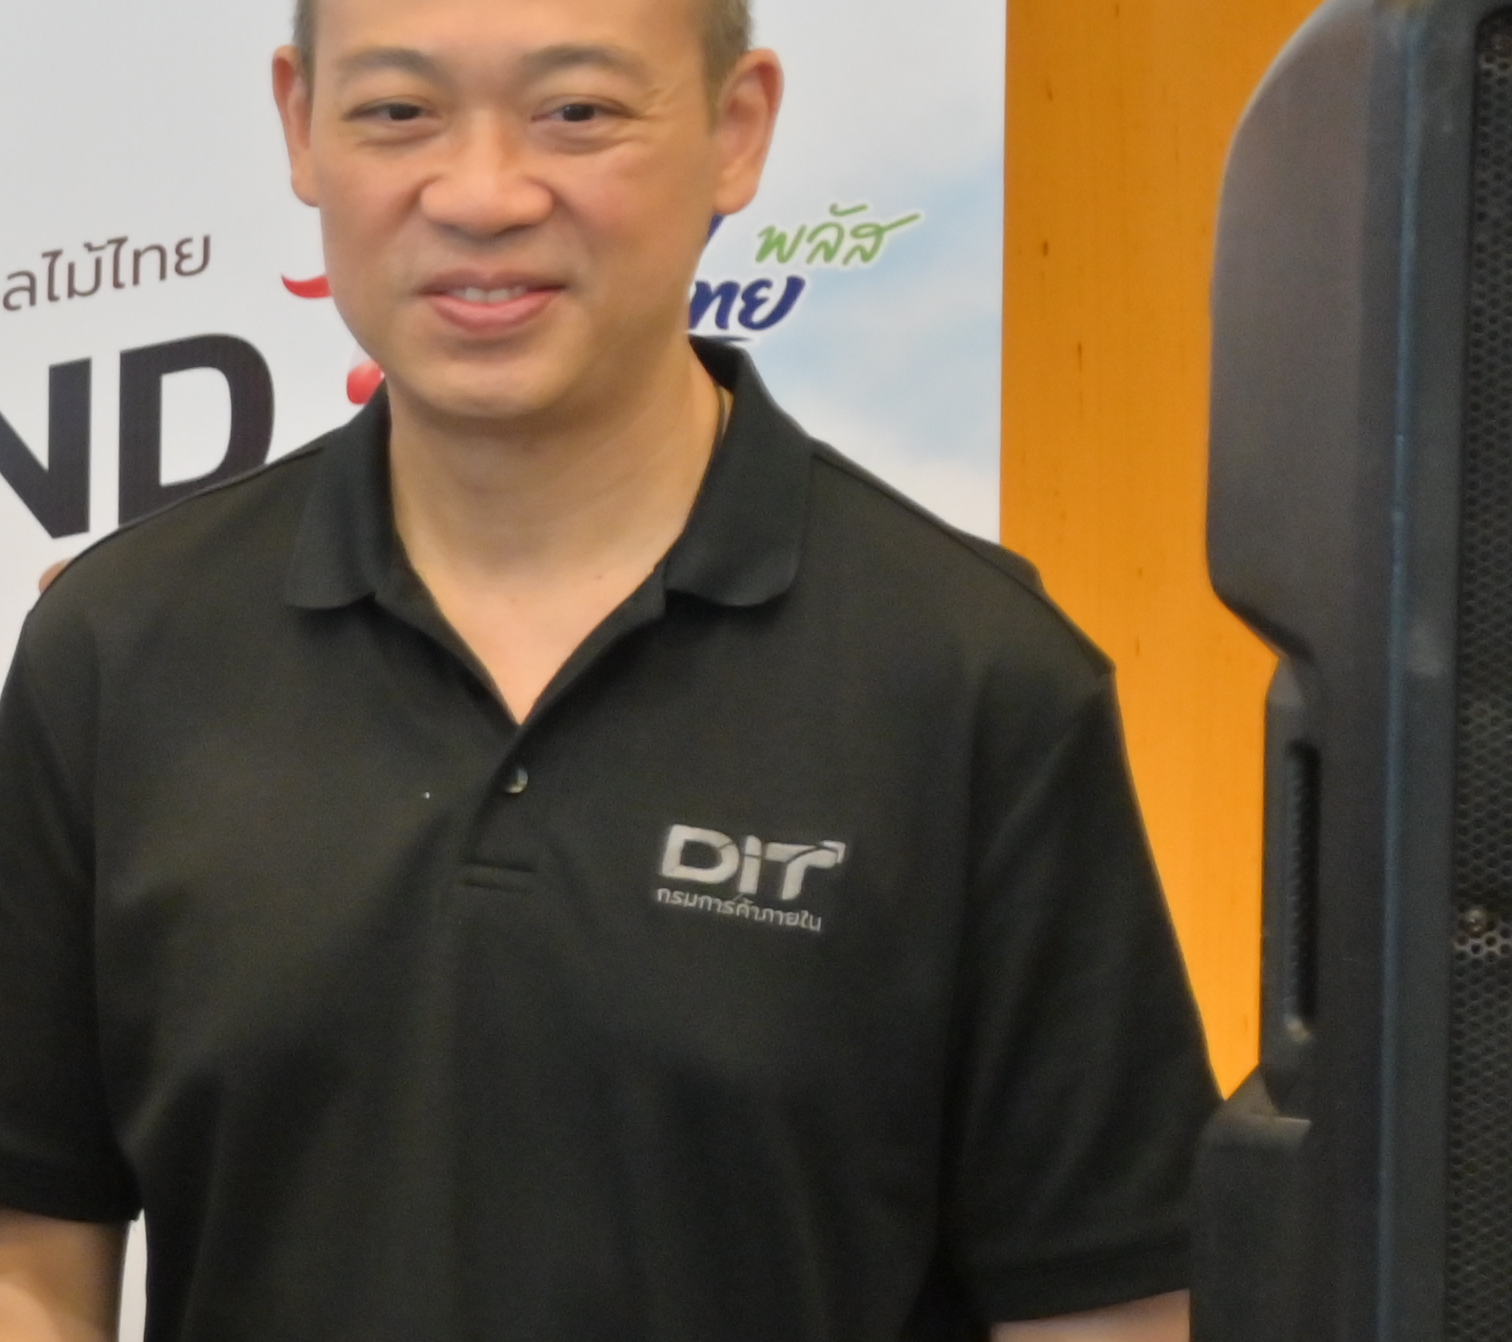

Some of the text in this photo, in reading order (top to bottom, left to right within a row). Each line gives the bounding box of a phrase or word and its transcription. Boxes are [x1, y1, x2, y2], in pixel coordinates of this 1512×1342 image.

[755, 203, 920, 266] พลัส
[656, 887, 822, 933] กรมการค้าภายใน
